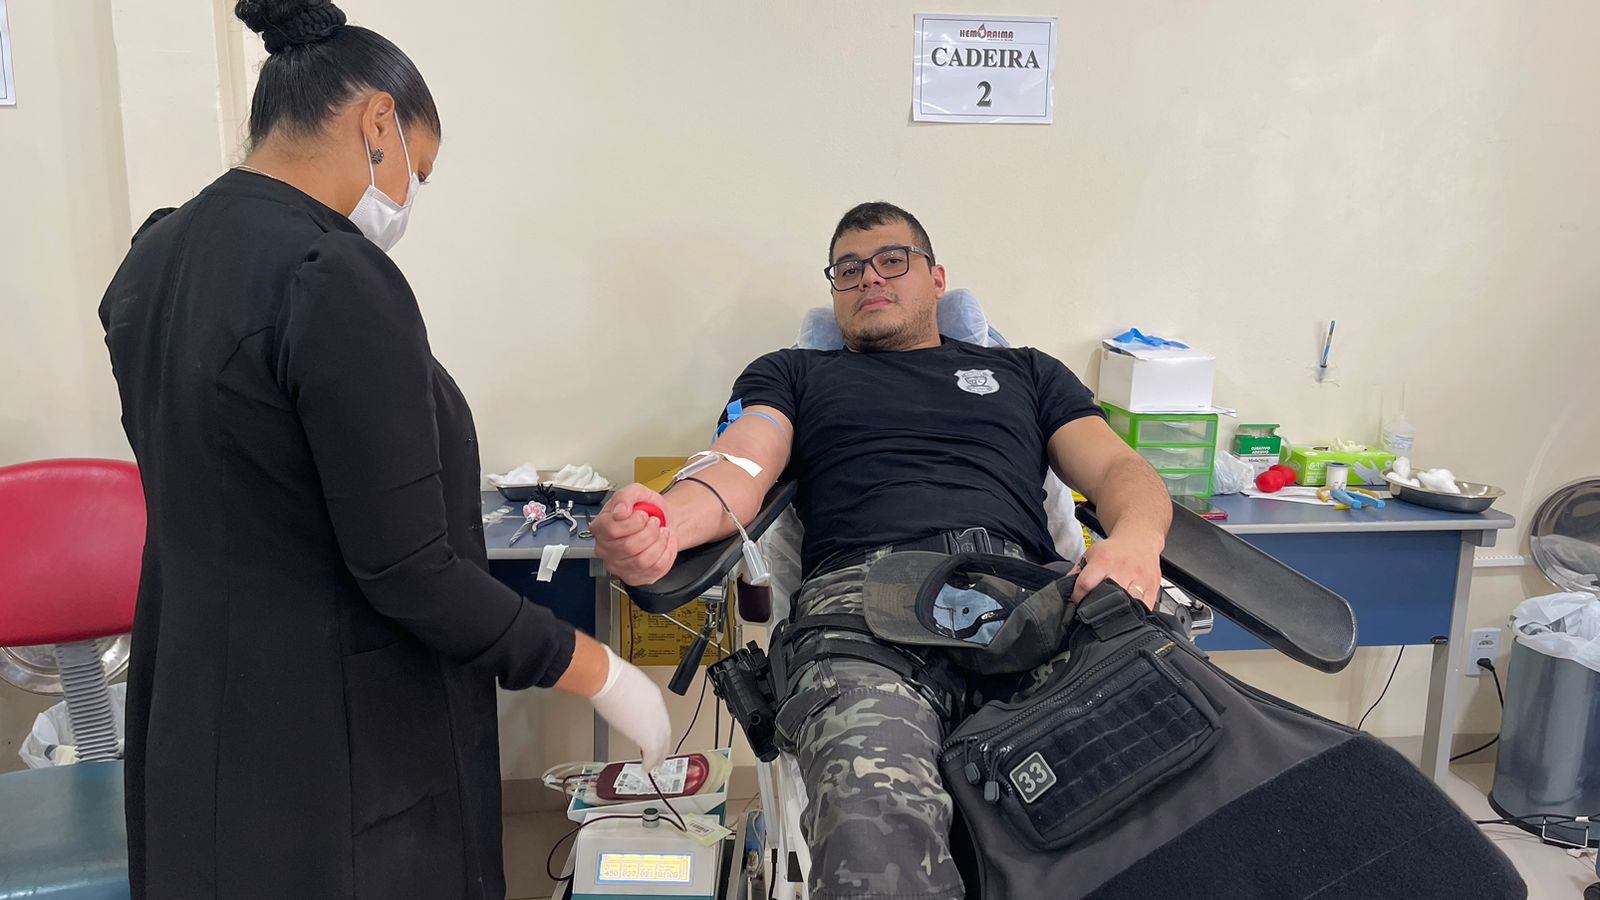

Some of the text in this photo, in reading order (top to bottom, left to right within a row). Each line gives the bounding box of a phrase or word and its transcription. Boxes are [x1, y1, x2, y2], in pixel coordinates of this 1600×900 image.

[959, 25, 1014, 39] HEMORAIMA
[931, 47, 1040, 69] CADEIRA
[976, 80, 992, 107] 2
[1018, 762, 1047, 793] 33
